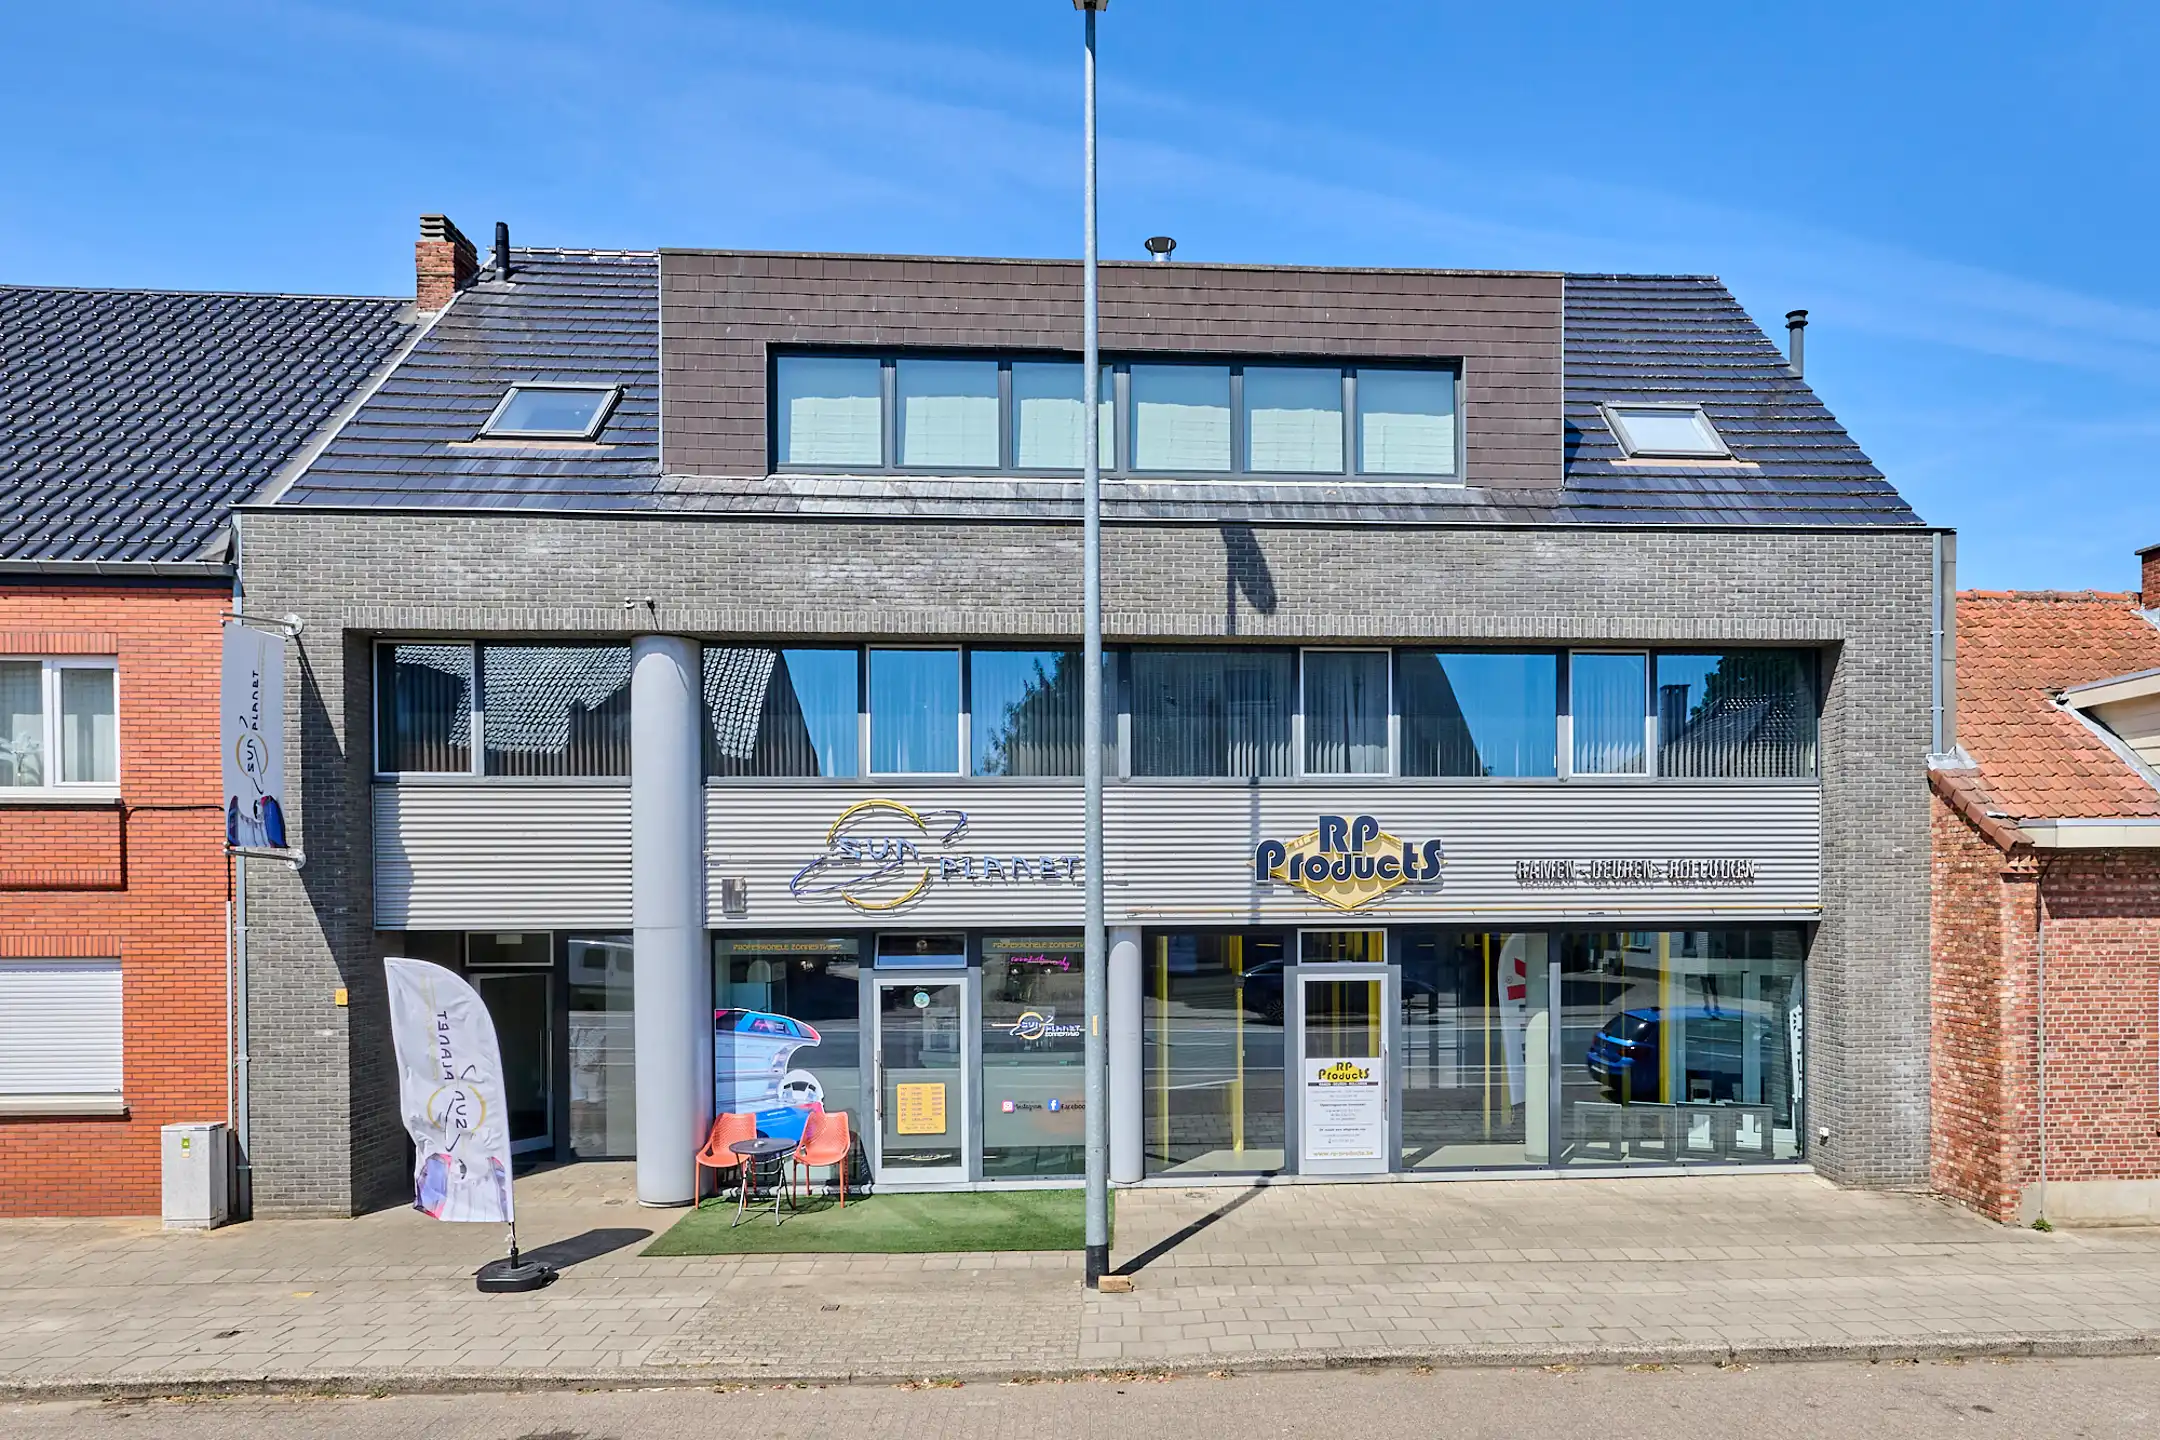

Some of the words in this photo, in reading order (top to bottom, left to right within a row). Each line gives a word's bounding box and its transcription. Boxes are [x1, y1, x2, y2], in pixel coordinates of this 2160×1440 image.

[246, 738, 255, 772] SUN
[251, 669, 260, 731] PLANET
[1318, 815, 1380, 853] RP
[837, 837, 919, 861] SUN
[1255, 838, 1443, 882] Products
[939, 855, 1081, 880] PLANET
[1515, 860, 1577, 881] RAMEN
[1590, 860, 1653, 881] DEUREN
[1318, 1068, 1370, 1080] Products
[1336, 1062, 1353, 1071] RP
